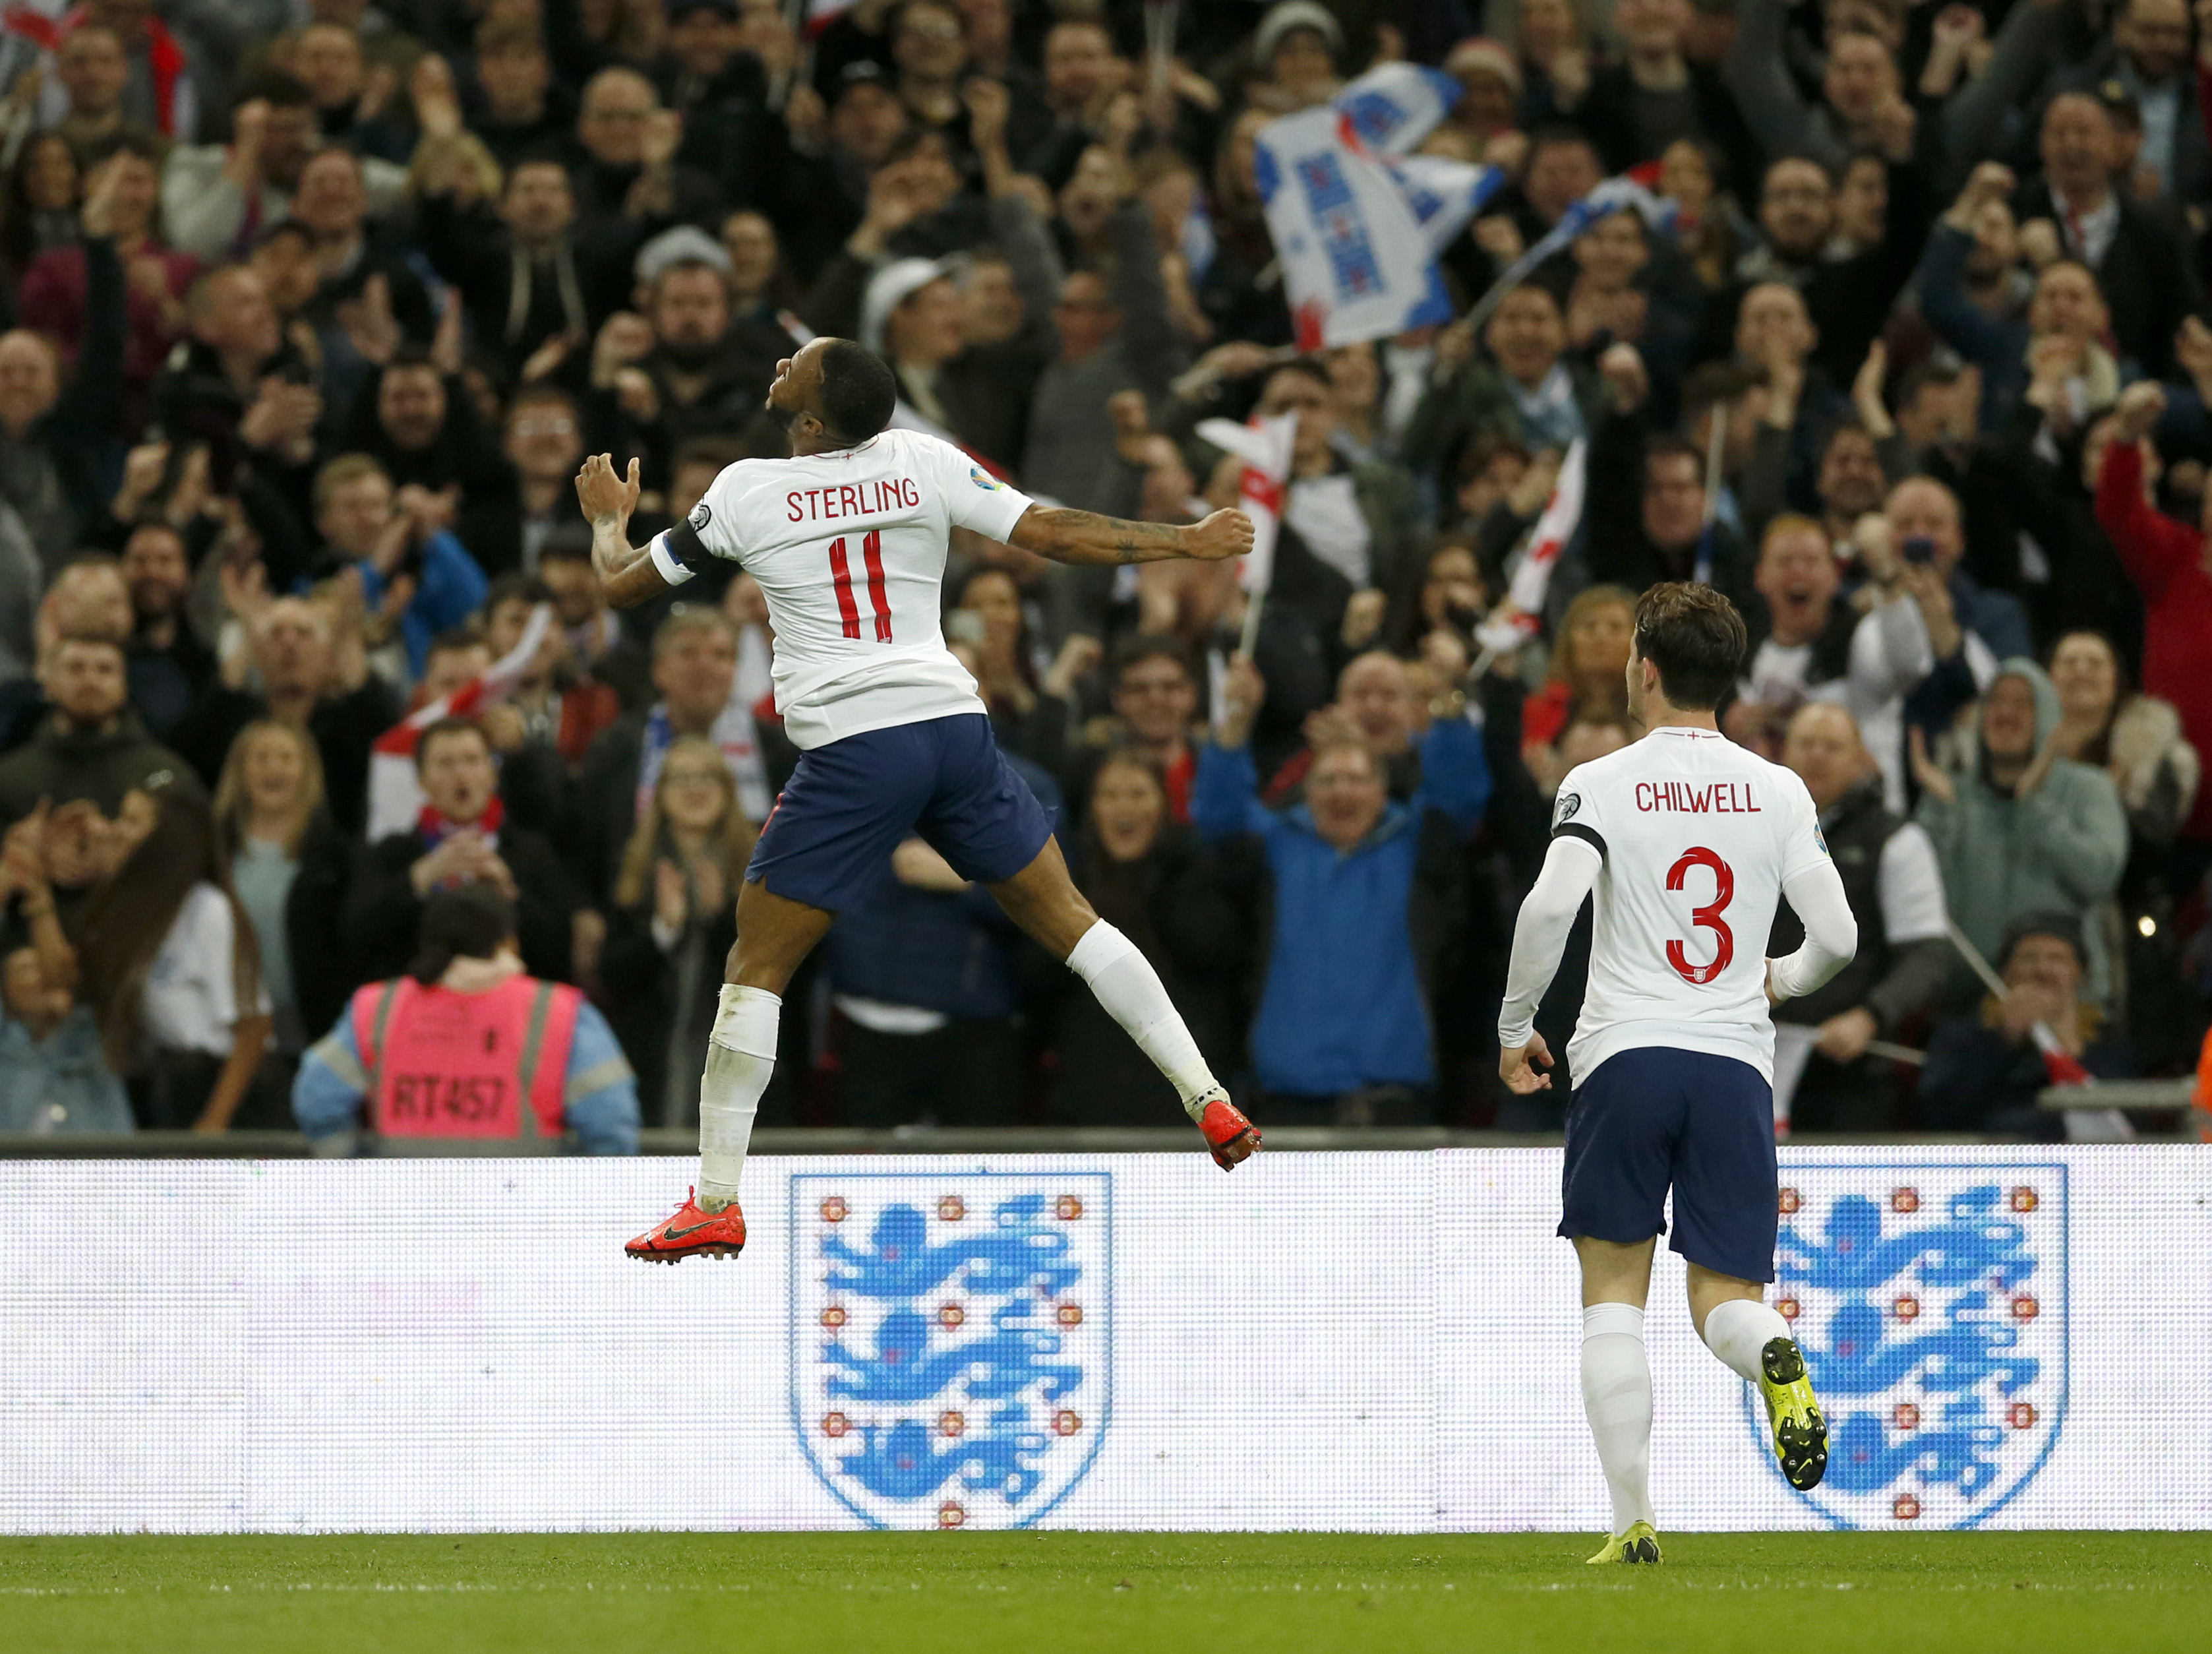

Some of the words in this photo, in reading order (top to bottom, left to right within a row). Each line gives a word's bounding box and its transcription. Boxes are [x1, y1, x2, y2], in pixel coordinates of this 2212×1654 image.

[787, 478, 919, 522] STERLING
[829, 530, 892, 644] 11
[1636, 782, 1761, 812] CHILWELL
[1666, 847, 1734, 984] 3
[392, 1075, 505, 1121] RT457
